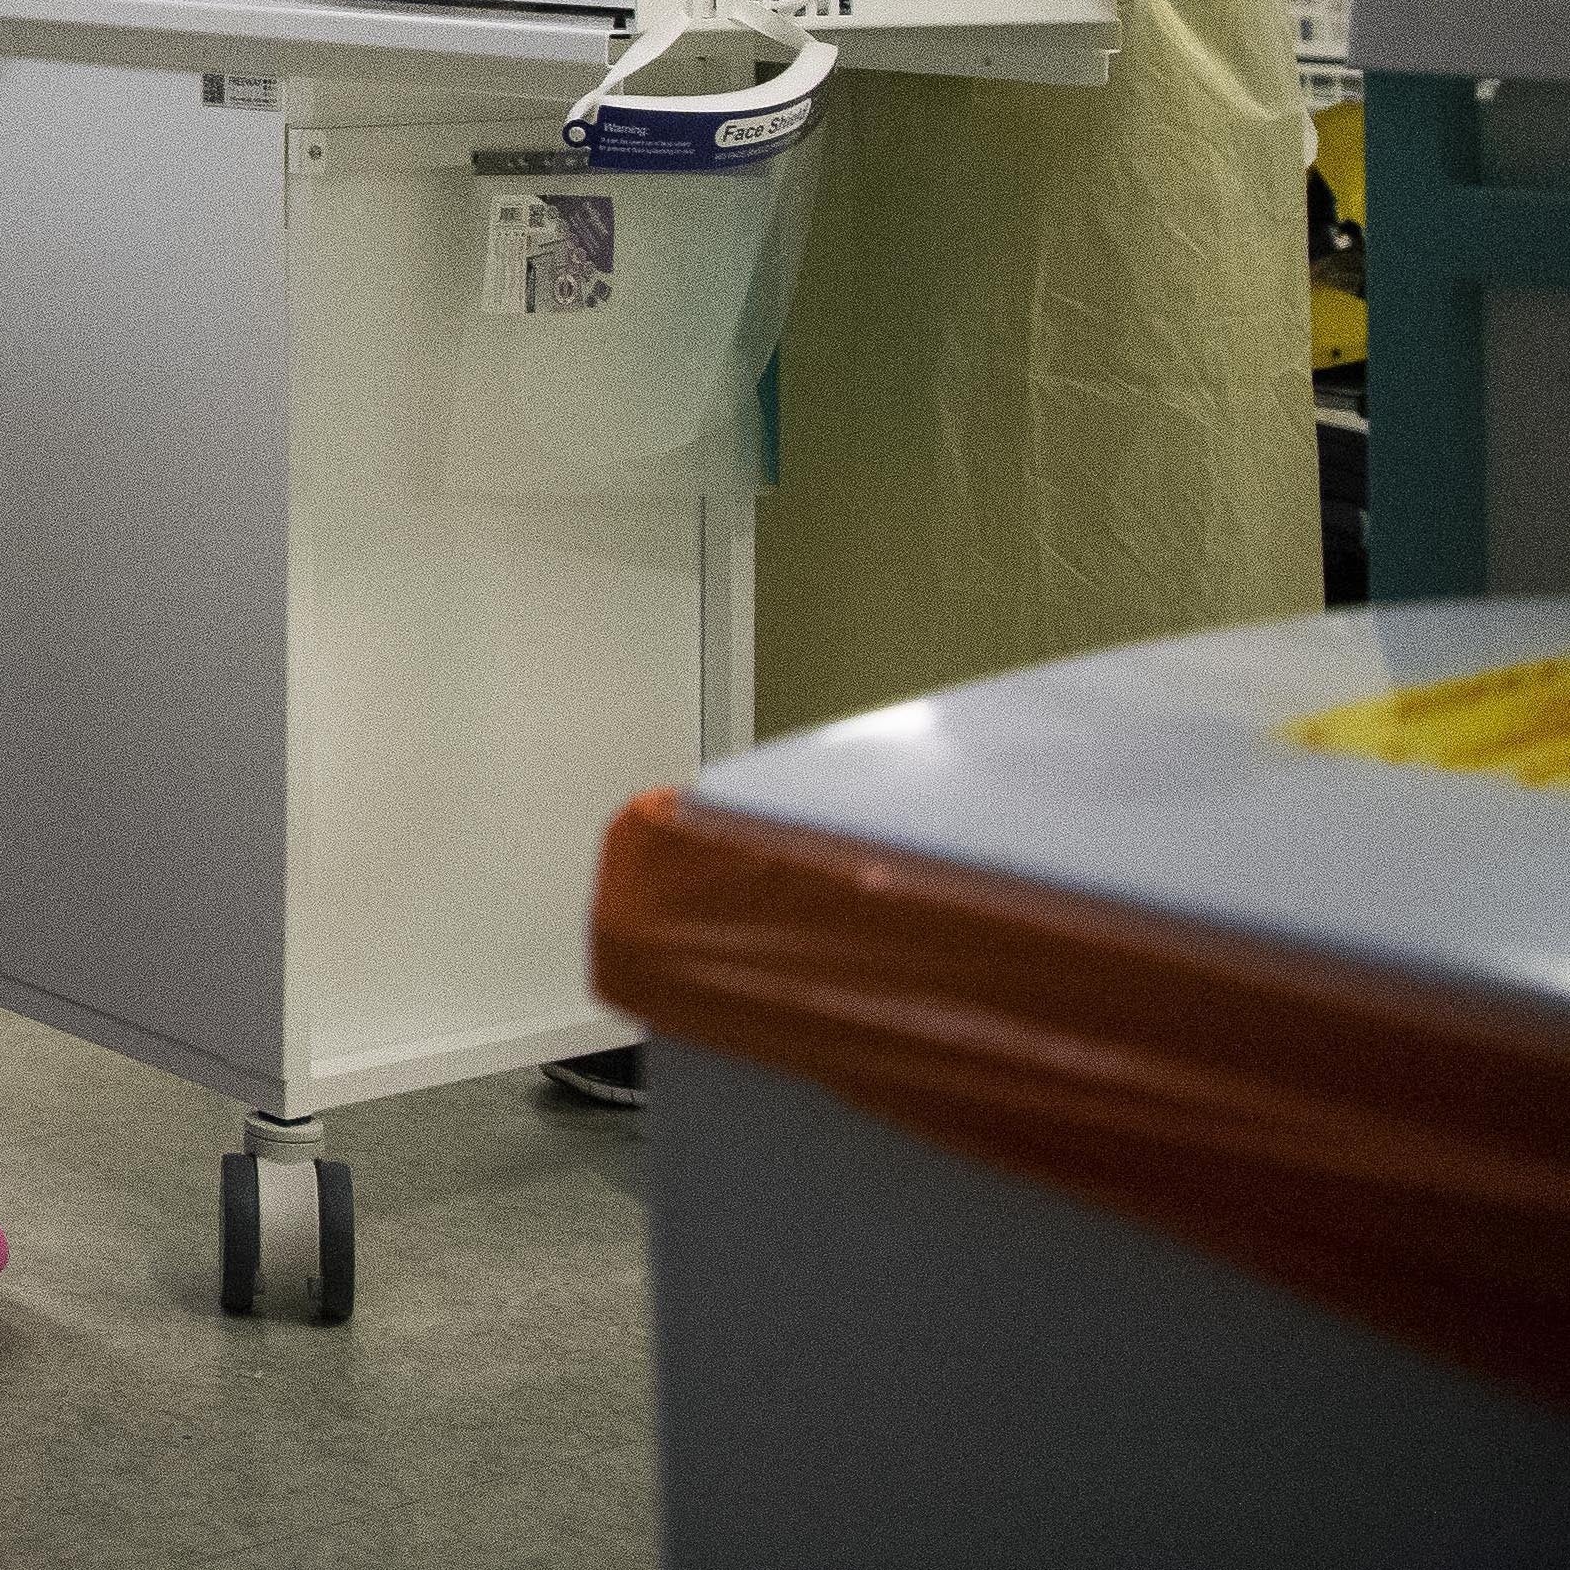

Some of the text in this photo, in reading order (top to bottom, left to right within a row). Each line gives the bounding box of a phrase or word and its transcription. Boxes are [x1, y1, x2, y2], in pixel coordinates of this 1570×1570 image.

[603, 122, 650, 137] Warning:
[722, 124, 765, 142] Face
[768, 104, 810, 134] Shield
